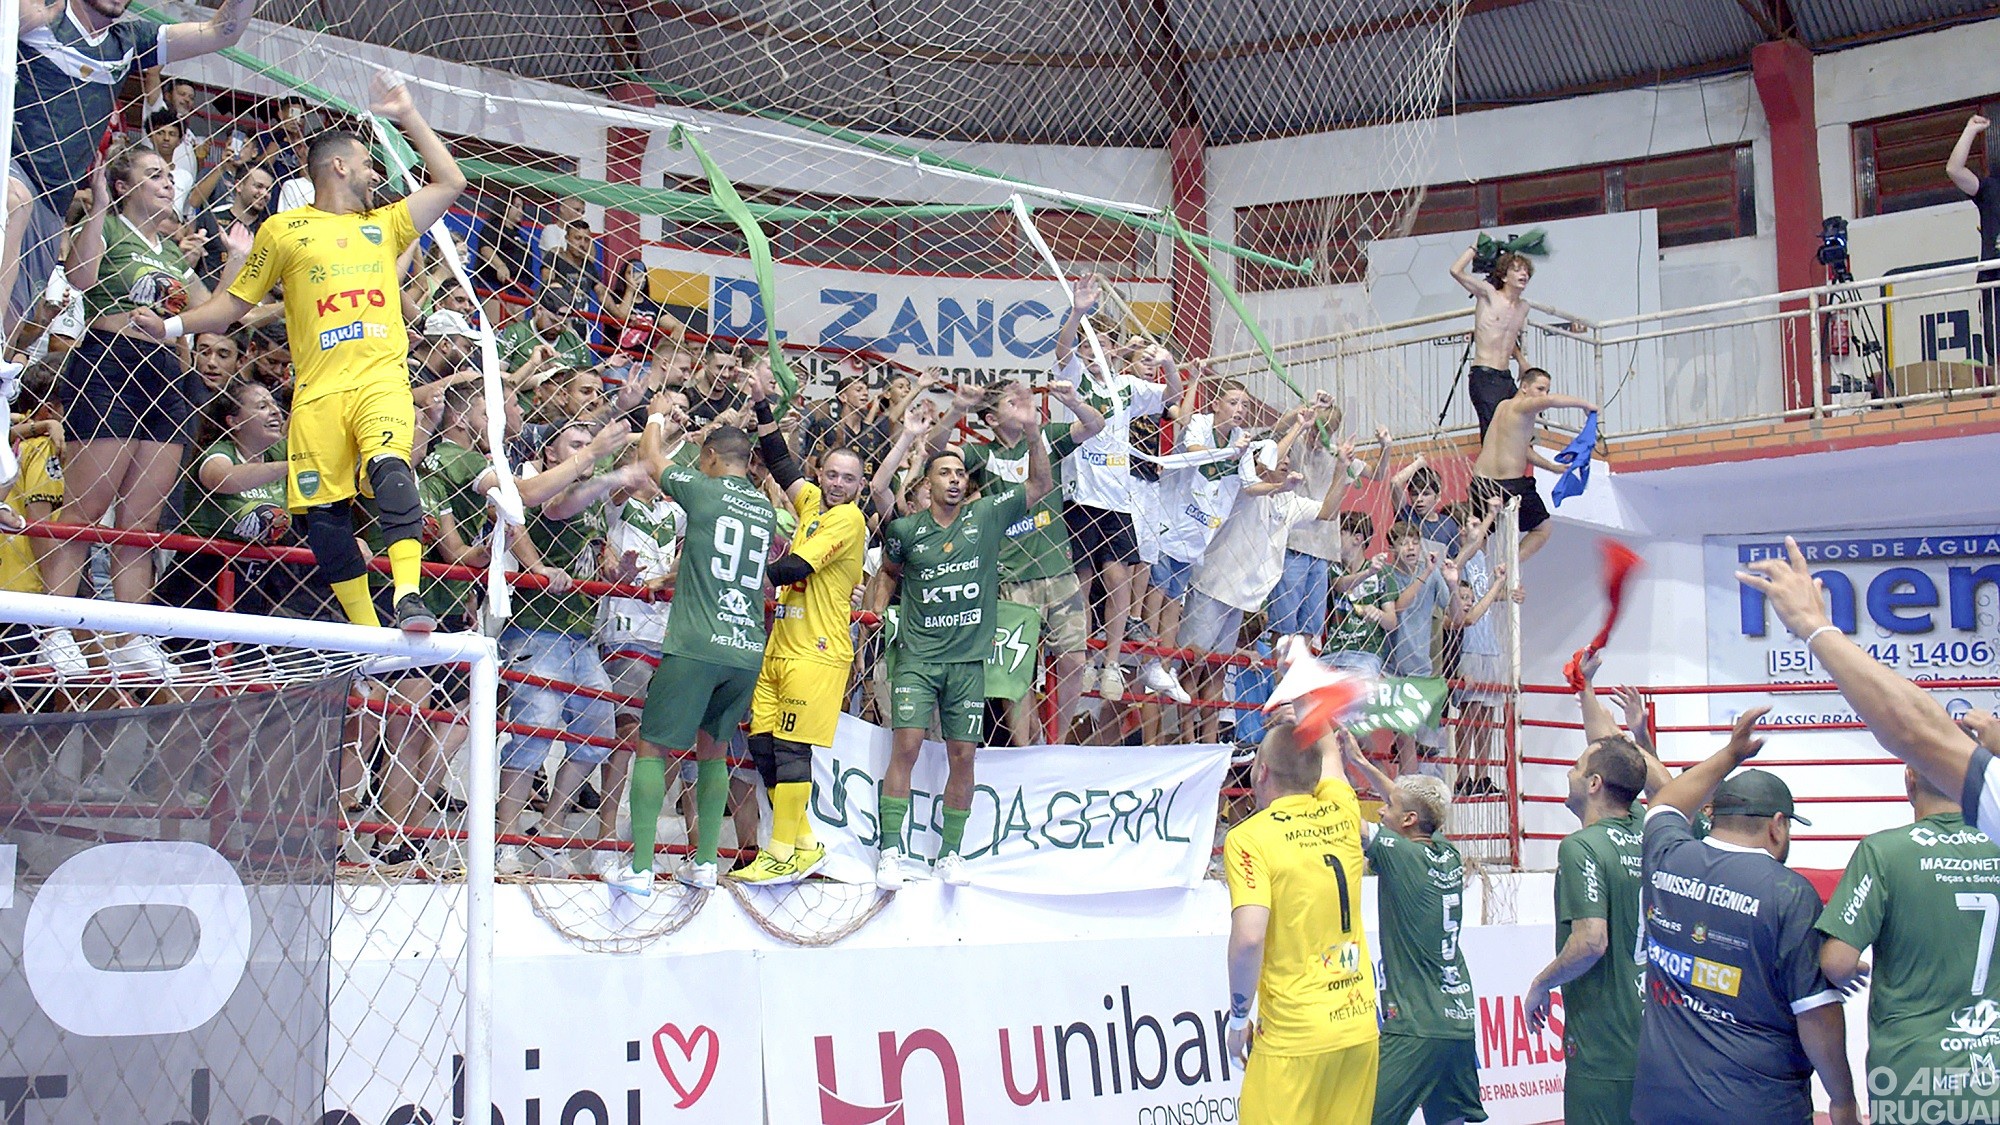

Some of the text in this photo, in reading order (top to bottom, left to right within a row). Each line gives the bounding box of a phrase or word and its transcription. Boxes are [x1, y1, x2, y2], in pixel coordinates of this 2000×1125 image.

[330, 260, 384, 277] Sicredi
[316, 288, 386, 318] KTO
[364, 323, 389, 339] TEC
[380, 431, 394, 448] 2
[721, 493, 774, 519] MAZZONETTO
[710, 515, 771, 591] 93
[1750, 537, 2000, 562] FILROS DE ÁGUA
[936, 555, 979, 577] Sicredi
[921, 582, 980, 604] KTO
[924, 611, 981, 629] BAKOF TEC
[1912, 640, 1988, 664] 1406
[780, 710, 797, 733] 18
[967, 714, 984, 735] 77
[1041, 782, 1190, 850] GERAL
[1584, 859, 1599, 903] creluz
[1935, 873, 1963, 884] Peças
[1966, 875, 1973, 883] e
[1322, 853, 1352, 934] 1
[1706, 883, 1760, 917] TÉCNICA
[1842, 873, 1873, 926] creluz
[1440, 893, 1461, 961] 5
[1670, 921, 1682, 932] RS
[1954, 892, 2000, 996] 7
[1694, 960, 1736, 991] TEC
[1479, 991, 1566, 1069] MAIS
[1494, 1081, 1519, 1100] PARA
[1519, 1079, 1541, 1098] SUA
[1138, 1094, 1240, 1125] CONSÓRCI
